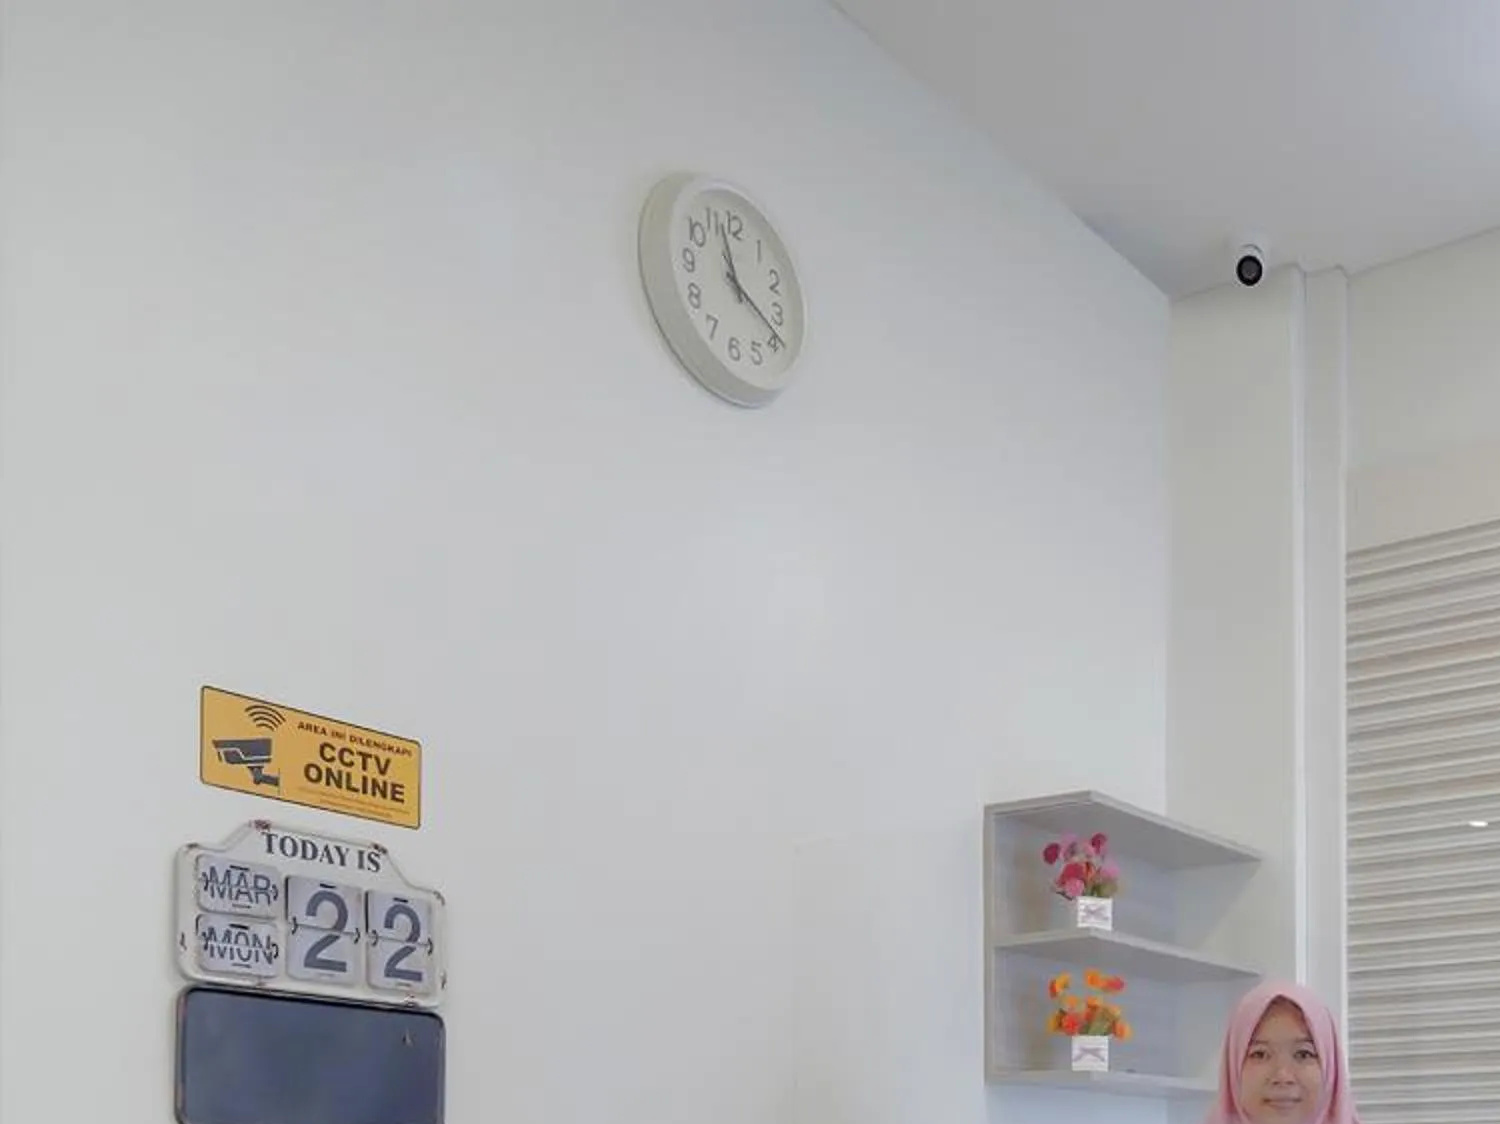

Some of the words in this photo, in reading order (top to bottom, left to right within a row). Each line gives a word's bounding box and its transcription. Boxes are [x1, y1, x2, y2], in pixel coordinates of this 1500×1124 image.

[688, 216, 706, 247] 10
[706, 207, 719, 236] 11
[726, 210, 744, 241] 12
[682, 247, 696, 272] 9
[687, 282, 702, 309] 8
[769, 268, 782, 295] 2
[705, 314, 719, 340] 7
[770, 302, 784, 326] 3
[728, 337, 742, 361] 6
[751, 340, 764, 365] 5
[297, 721, 327, 736] AREA
[349, 734, 412, 757] DILENGKAPI
[319, 741, 391, 775] CCTV
[303, 763, 405, 804] ONLINE
[262, 831, 348, 866] TODAY
[356, 850, 382, 873] IS
[209, 865, 271, 905] MAR
[208, 926, 273, 965] MON
